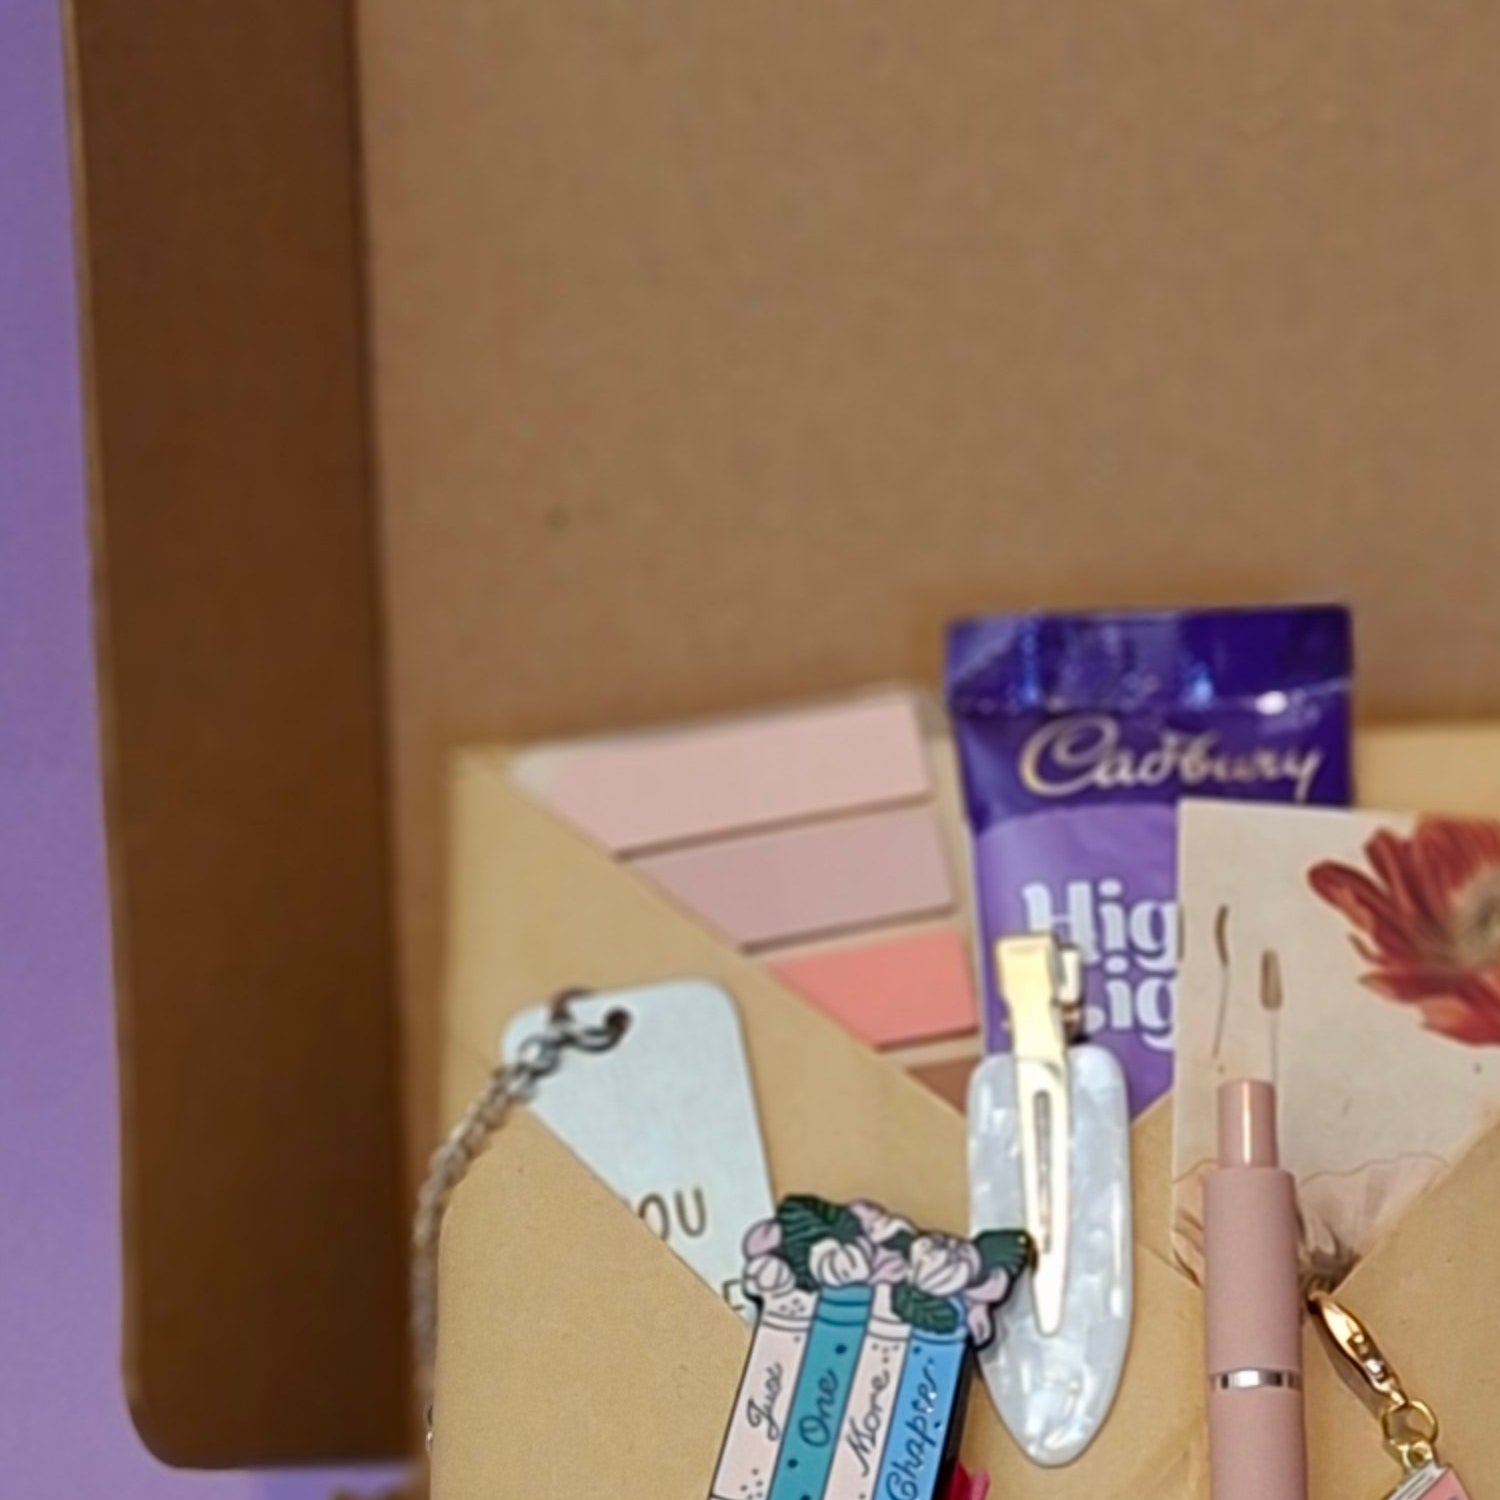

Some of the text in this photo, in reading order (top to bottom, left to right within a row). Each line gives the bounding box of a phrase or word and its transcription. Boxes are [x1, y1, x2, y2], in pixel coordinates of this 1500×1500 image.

[1018, 712, 1323, 802] Cadbury
[1080, 954, 1177, 1050] ig
[798, 1368, 839, 1448] One
[845, 1369, 890, 1478] More
